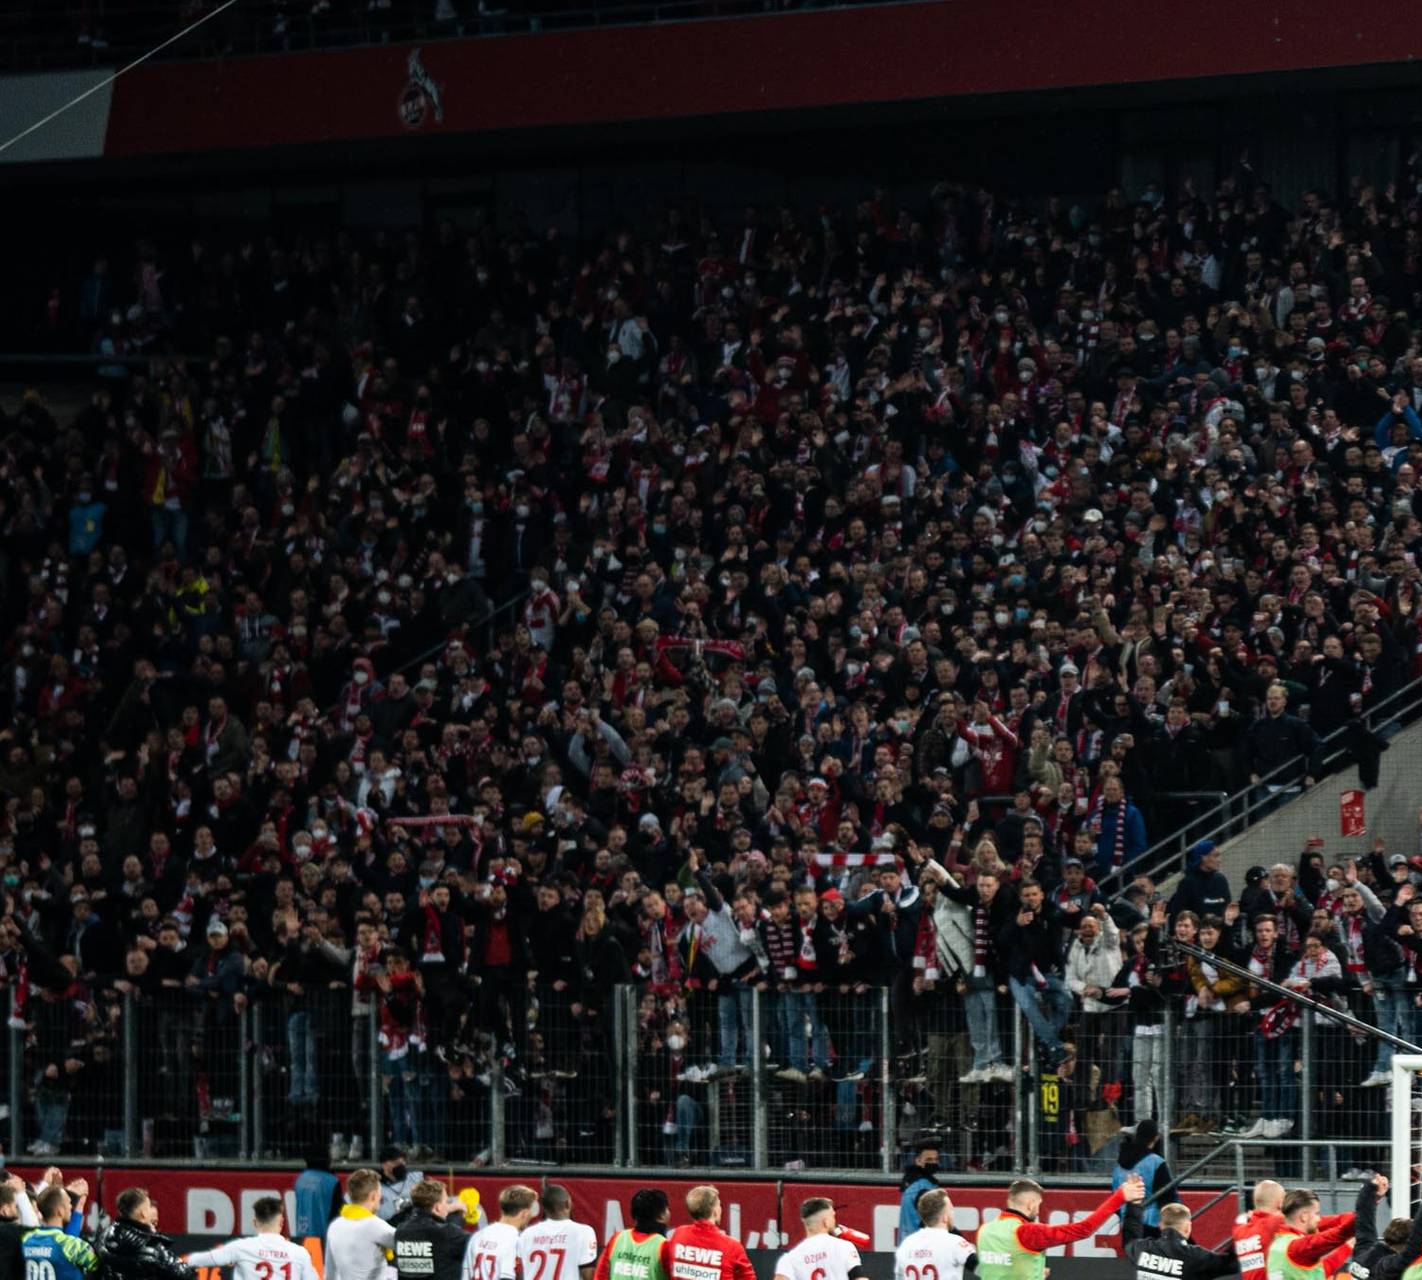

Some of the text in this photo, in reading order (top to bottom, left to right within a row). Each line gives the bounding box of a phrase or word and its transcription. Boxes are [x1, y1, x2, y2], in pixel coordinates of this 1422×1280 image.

[1040, 1082, 1060, 1115] 19
[396, 1240, 434, 1257] REWE
[674, 1243, 724, 1265] REWE
[528, 1248, 567, 1280] 27
[674, 1264, 719, 1279] uhlsport
[1137, 1251, 1184, 1276] REWE
